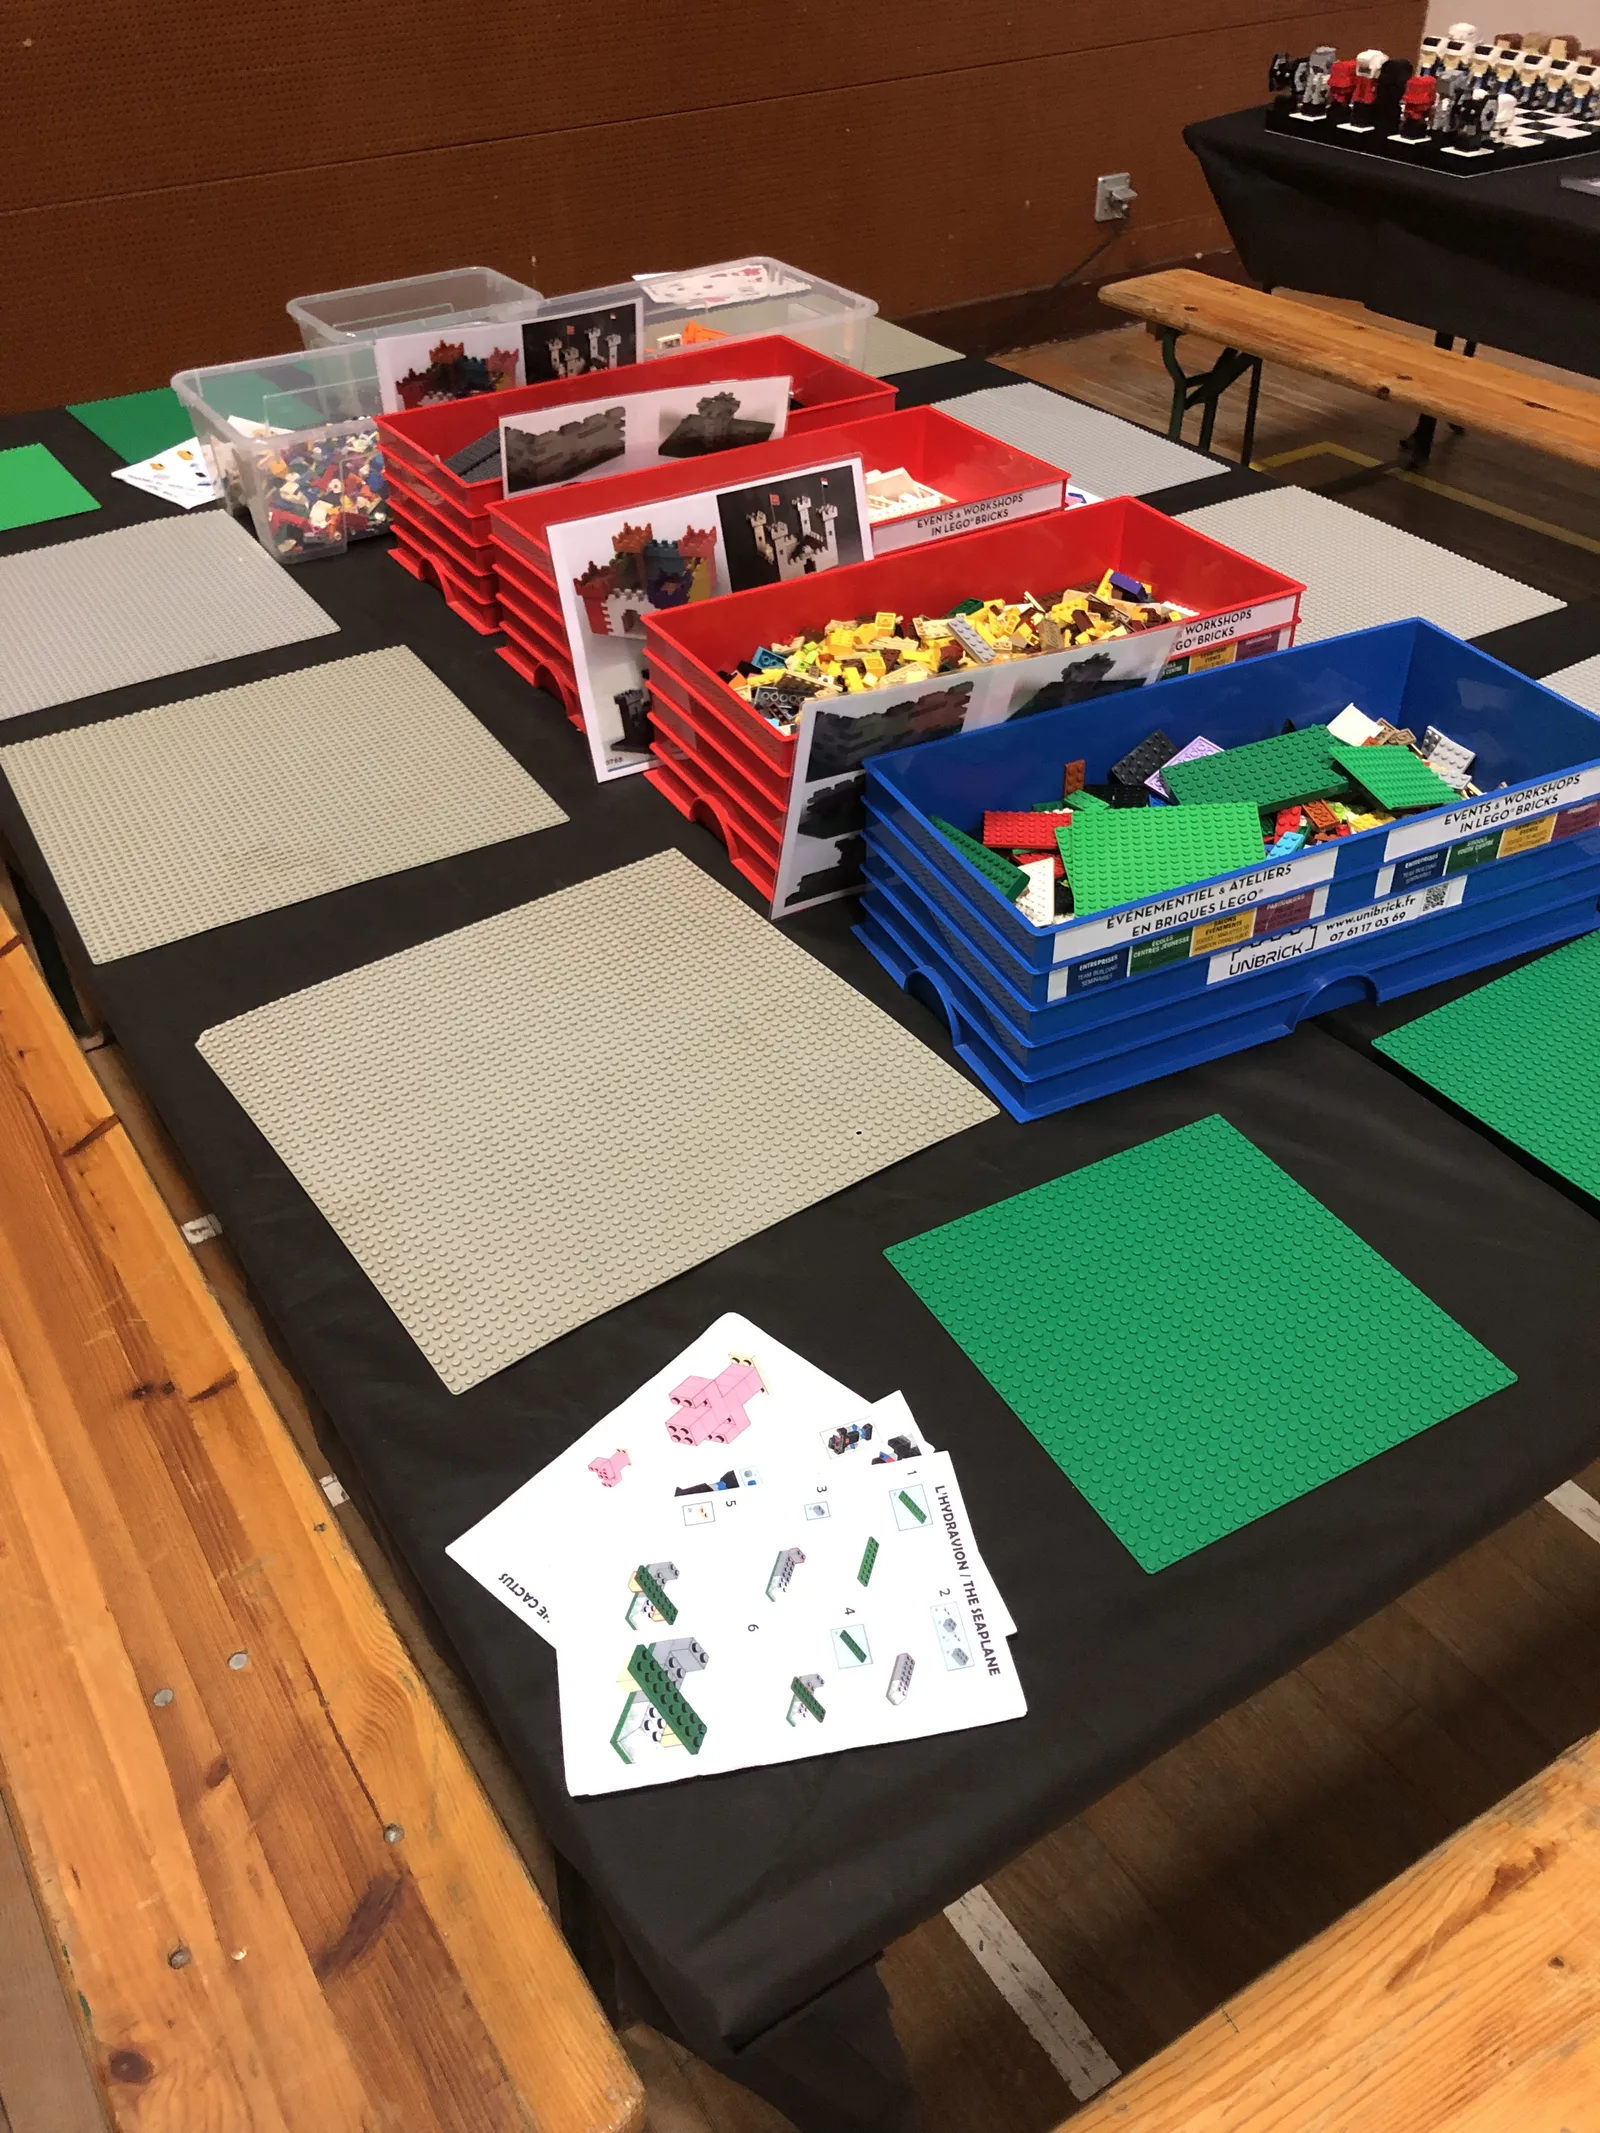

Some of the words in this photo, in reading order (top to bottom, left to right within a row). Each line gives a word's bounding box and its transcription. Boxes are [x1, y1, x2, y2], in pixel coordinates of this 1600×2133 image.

[917, 512, 954, 528] EVENTS
[956, 512, 963, 520] &
[963, 493, 1024, 517] WORKSHOPS
[931, 526, 942, 537] IN
[975, 508, 1009, 525] BRICKS
[1185, 609, 1252, 635] WORKSHOPS
[1197, 626, 1235, 645] BRICKS
[1444, 802, 1492, 826] EVENTS
[1493, 801, 1501, 811] &
[1504, 774, 1581, 806] WORKSHOPS
[1460, 820, 1474, 833] IN
[1515, 793, 1559, 816] BRICKS
[1218, 886, 1226, 895] &
[1229, 863, 1293, 895] ATELIERS
[1132, 922, 1151, 937] EN
[1155, 903, 1216, 930] BRIQUES
[1325, 895, 1417, 932] www.unibrick.fr
[1329, 929, 1343, 943] 07
[1346, 926, 1359, 937] 61
[1361, 922, 1373, 933] 17
[1374, 917, 1390, 929] 03
[1391, 911, 1406, 923] 69
[1133, 945, 1160, 958] CENTRES
[1160, 936, 1190, 950] JEUNESSE
[1079, 954, 1119, 971] ENTREPRISES
[726, 1499, 737, 1508] 5
[816, 1485, 828, 1493] 3
[935, 1485, 970, 1571] L'HYDRAVION
[498, 1573, 539, 1609] CACTUS
[939, 1587, 951, 1597] 2
[963, 1580, 980, 1606] THE
[844, 1607, 856, 1615] 4
[747, 1623, 759, 1632] 6
[971, 1607, 1001, 1676] SEAPLANE
